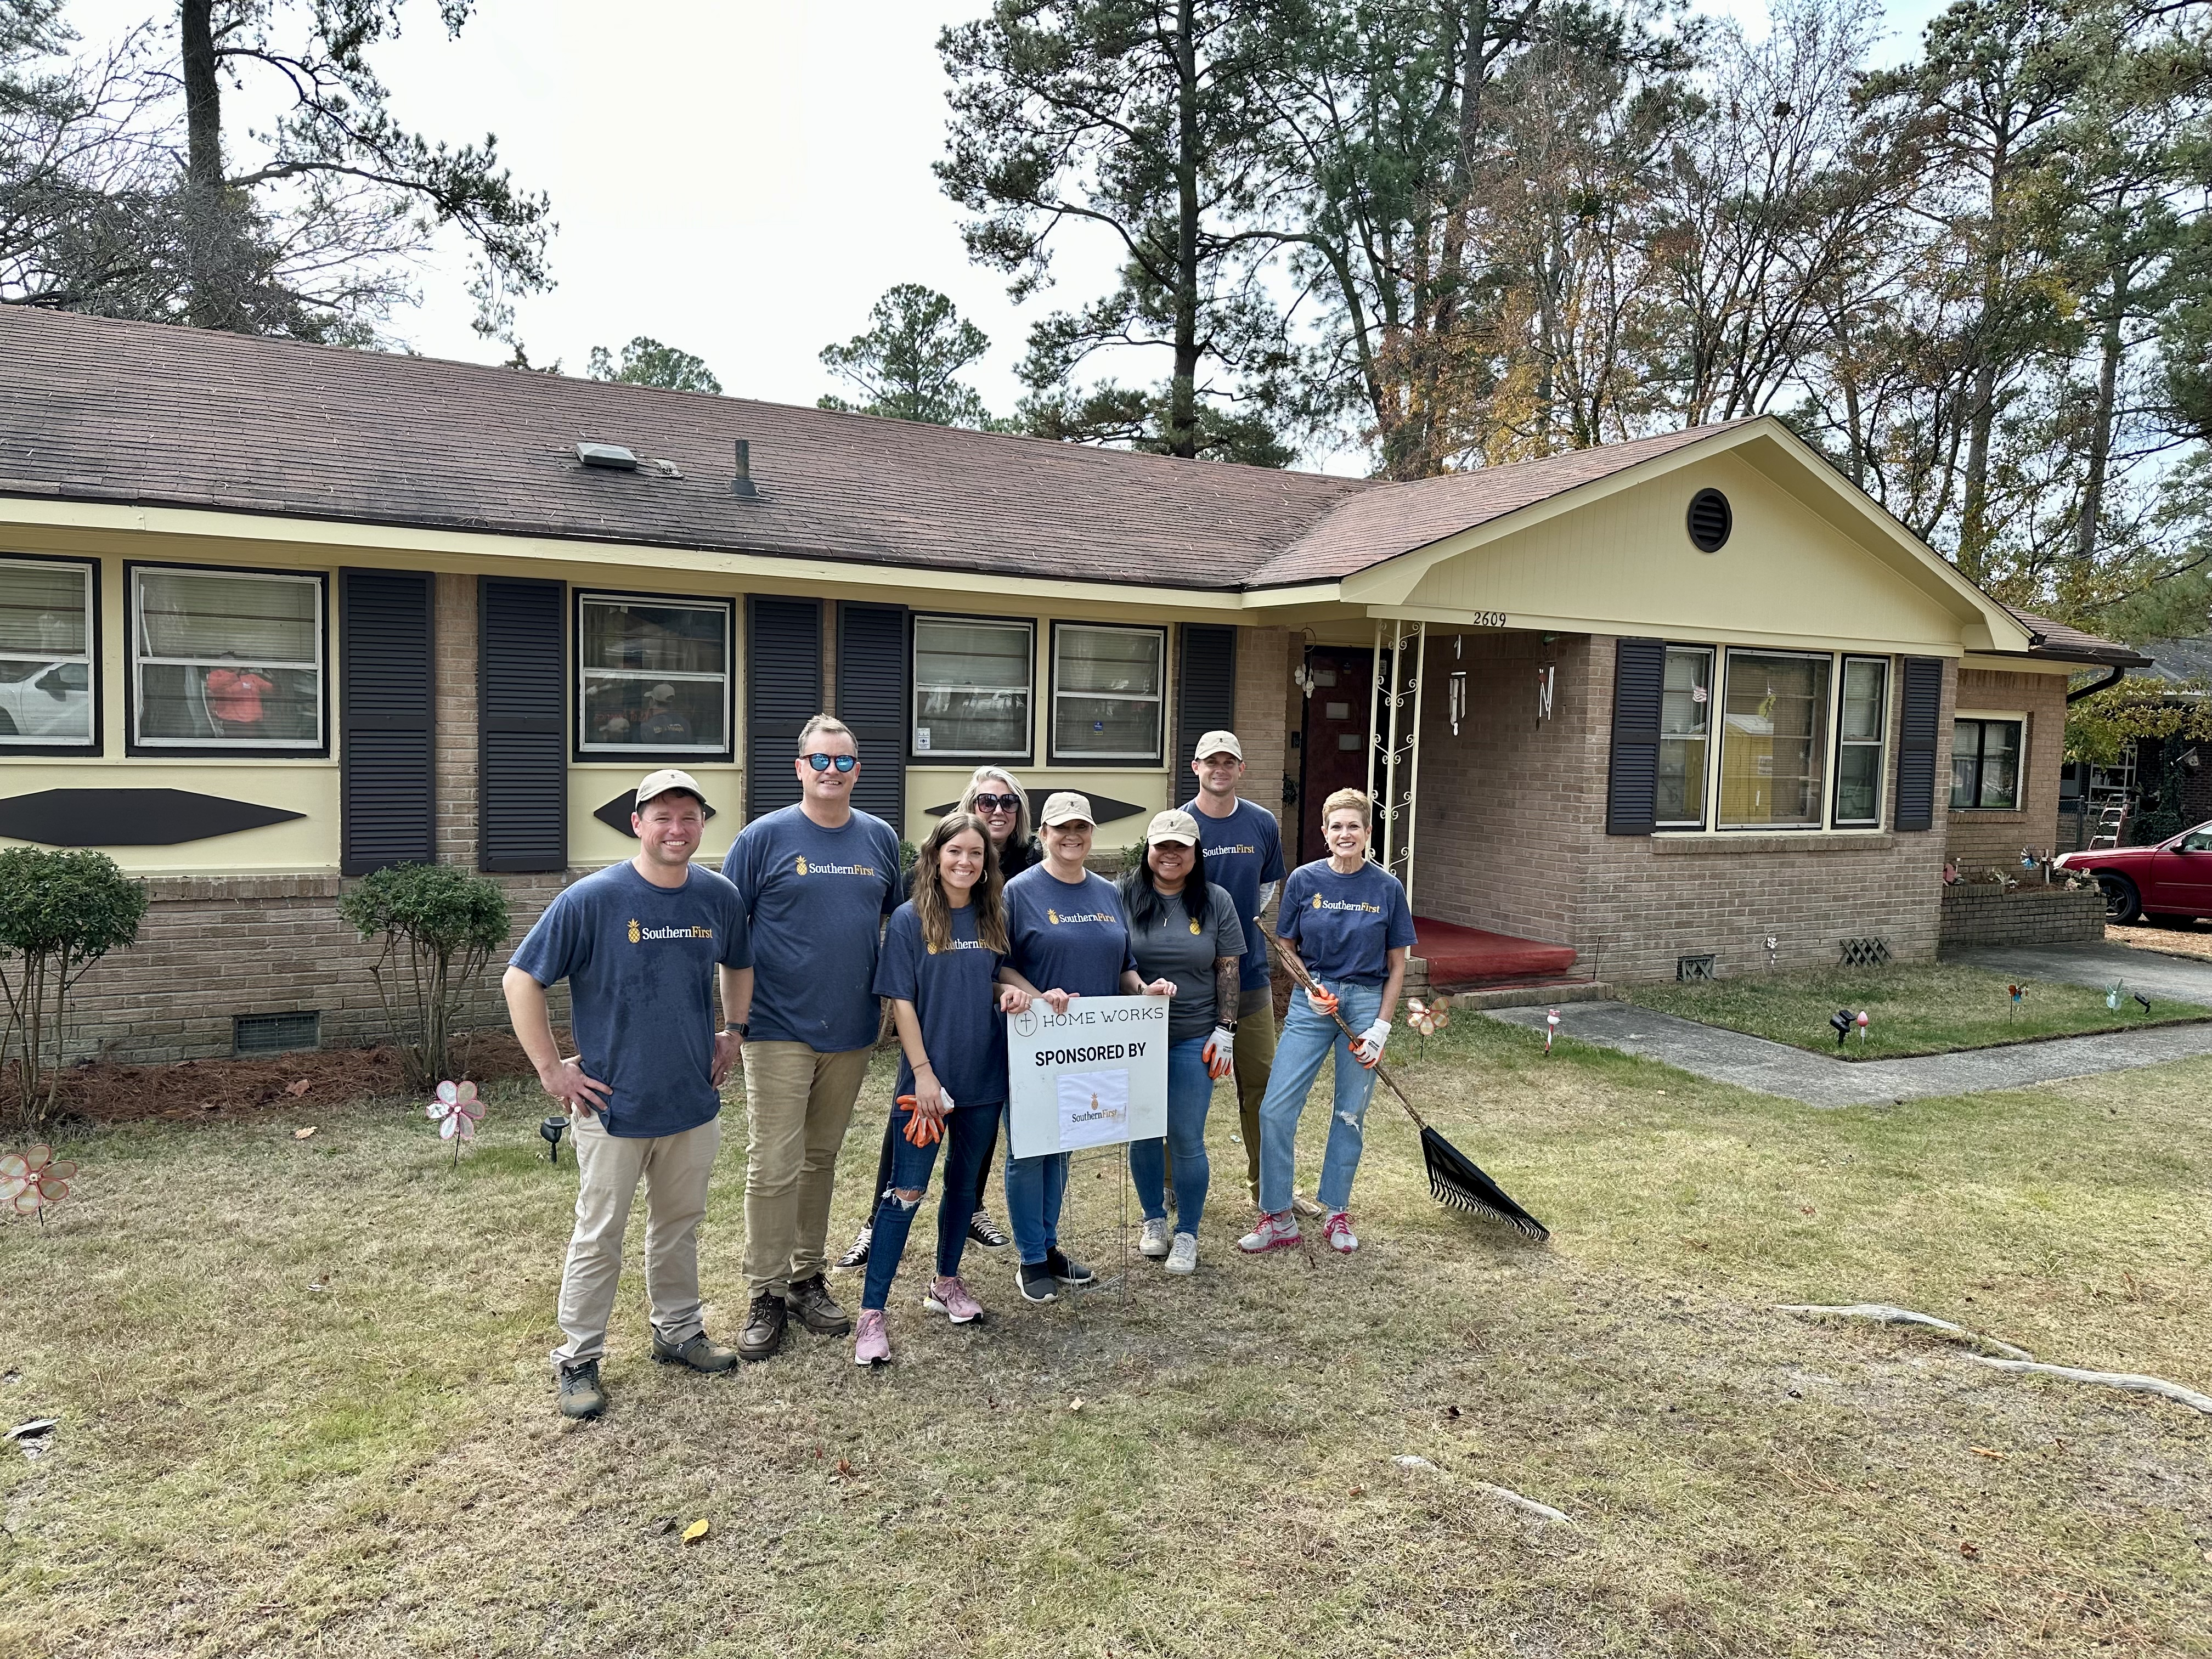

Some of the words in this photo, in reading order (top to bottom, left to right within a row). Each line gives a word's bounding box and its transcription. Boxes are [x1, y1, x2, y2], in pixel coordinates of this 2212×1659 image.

[1474, 611, 1506, 628] 2609
[1203, 844, 1255, 857] SouthernFirst
[809, 862, 875, 876] SouthernFirst
[1322, 900, 1380, 913] SouthernFirst
[1059, 913, 1116, 923] SouthernFirst
[642, 926, 713, 940] SouthernFirst
[1043, 1012, 1096, 1027] HOME
[1101, 1007, 1164, 1022] WORKS
[1035, 1045, 1124, 1066] SPONSORED
[1128, 1042, 1146, 1057] BY
[1072, 1109, 1118, 1122] SouthernFirst
